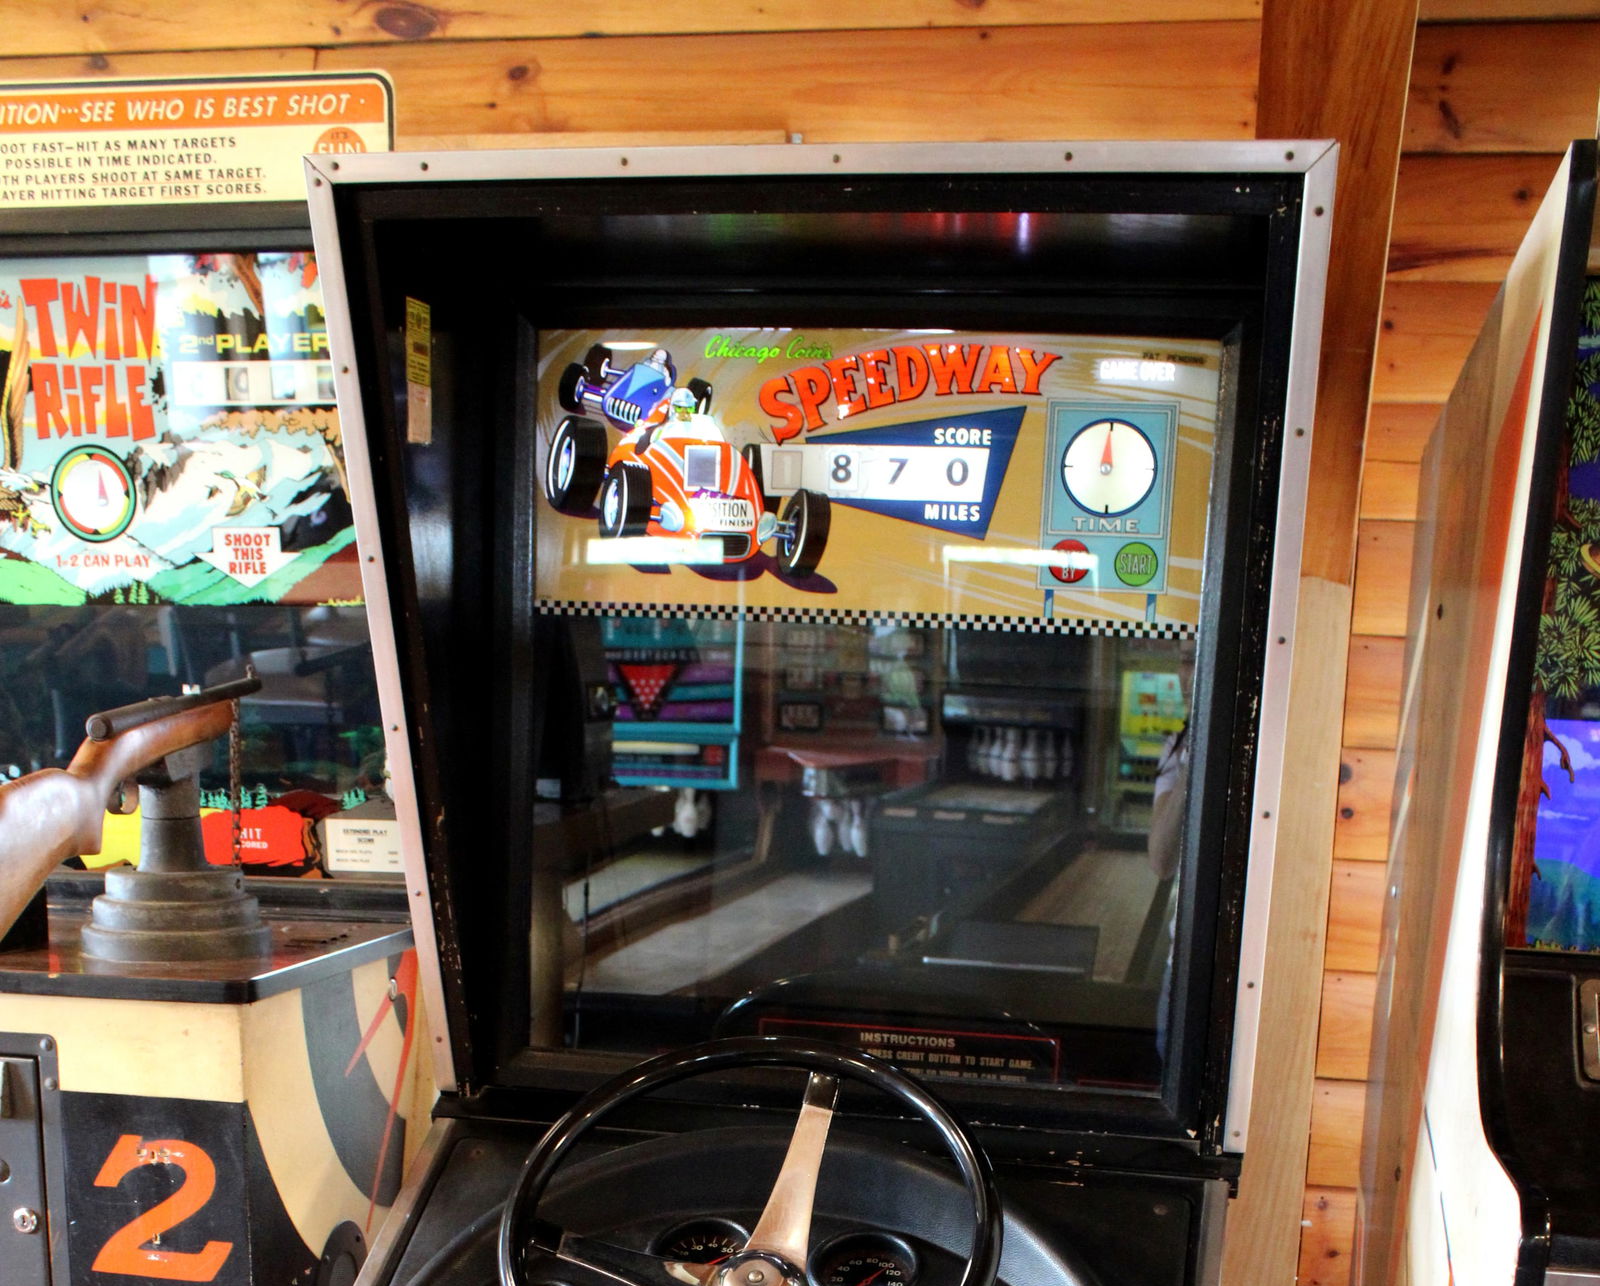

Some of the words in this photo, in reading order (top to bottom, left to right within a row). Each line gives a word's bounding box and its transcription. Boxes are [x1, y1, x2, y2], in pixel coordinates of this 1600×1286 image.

[127, 99, 185, 121] WHO
[194, 98, 216, 120] IS
[223, 95, 278, 118] BEST
[286, 93, 351, 116] SHOT
[104, 140, 121, 151] AS
[127, 139, 167, 151] MANY
[174, 136, 237, 149] TARGETS
[5, 157, 73, 170] POSSIBLE
[78, 156, 92, 168] IN
[97, 155, 131, 167] TIME
[137, 152, 217, 165] INDICATED.
[25, 173, 86, 185] PLAYERS
[92, 171, 137, 183] SHOOT
[142, 170, 158, 181] AT
[165, 169, 203, 181] SAME
[208, 167, 267, 179] TARGET.
[41, 187, 97, 200] HITTING
[103, 186, 155, 198] TARGET
[161, 184, 200, 196] FIRST
[206, 182, 267, 195] SCORES.
[705, 335, 781, 364] Chicago
[1100, 360, 1138, 381] GAME
[1141, 362, 1176, 382] OVER
[759, 344, 1063, 446] SPEEDWAY
[934, 427, 992, 446] SCORE
[924, 503, 981, 522] MILES
[1072, 516, 1140, 533] TIME
[224, 533, 271, 546] SHOOT
[84, 554, 110, 567] CAN
[114, 554, 151, 568] PLAY
[232, 548, 263, 560] THIS
[229, 562, 266, 574] RIFLE
[1119, 553, 1153, 576] START
[860, 1031, 956, 1048] INSTRUCTIONS
[928, 1052, 961, 1065] BUTTON
[965, 1055, 976, 1066] TO
[980, 1056, 1005, 1068] START
[92, 1134, 233, 1282] 2
[879, 1262, 895, 1270] 100
[886, 1269, 901, 1277] 120
